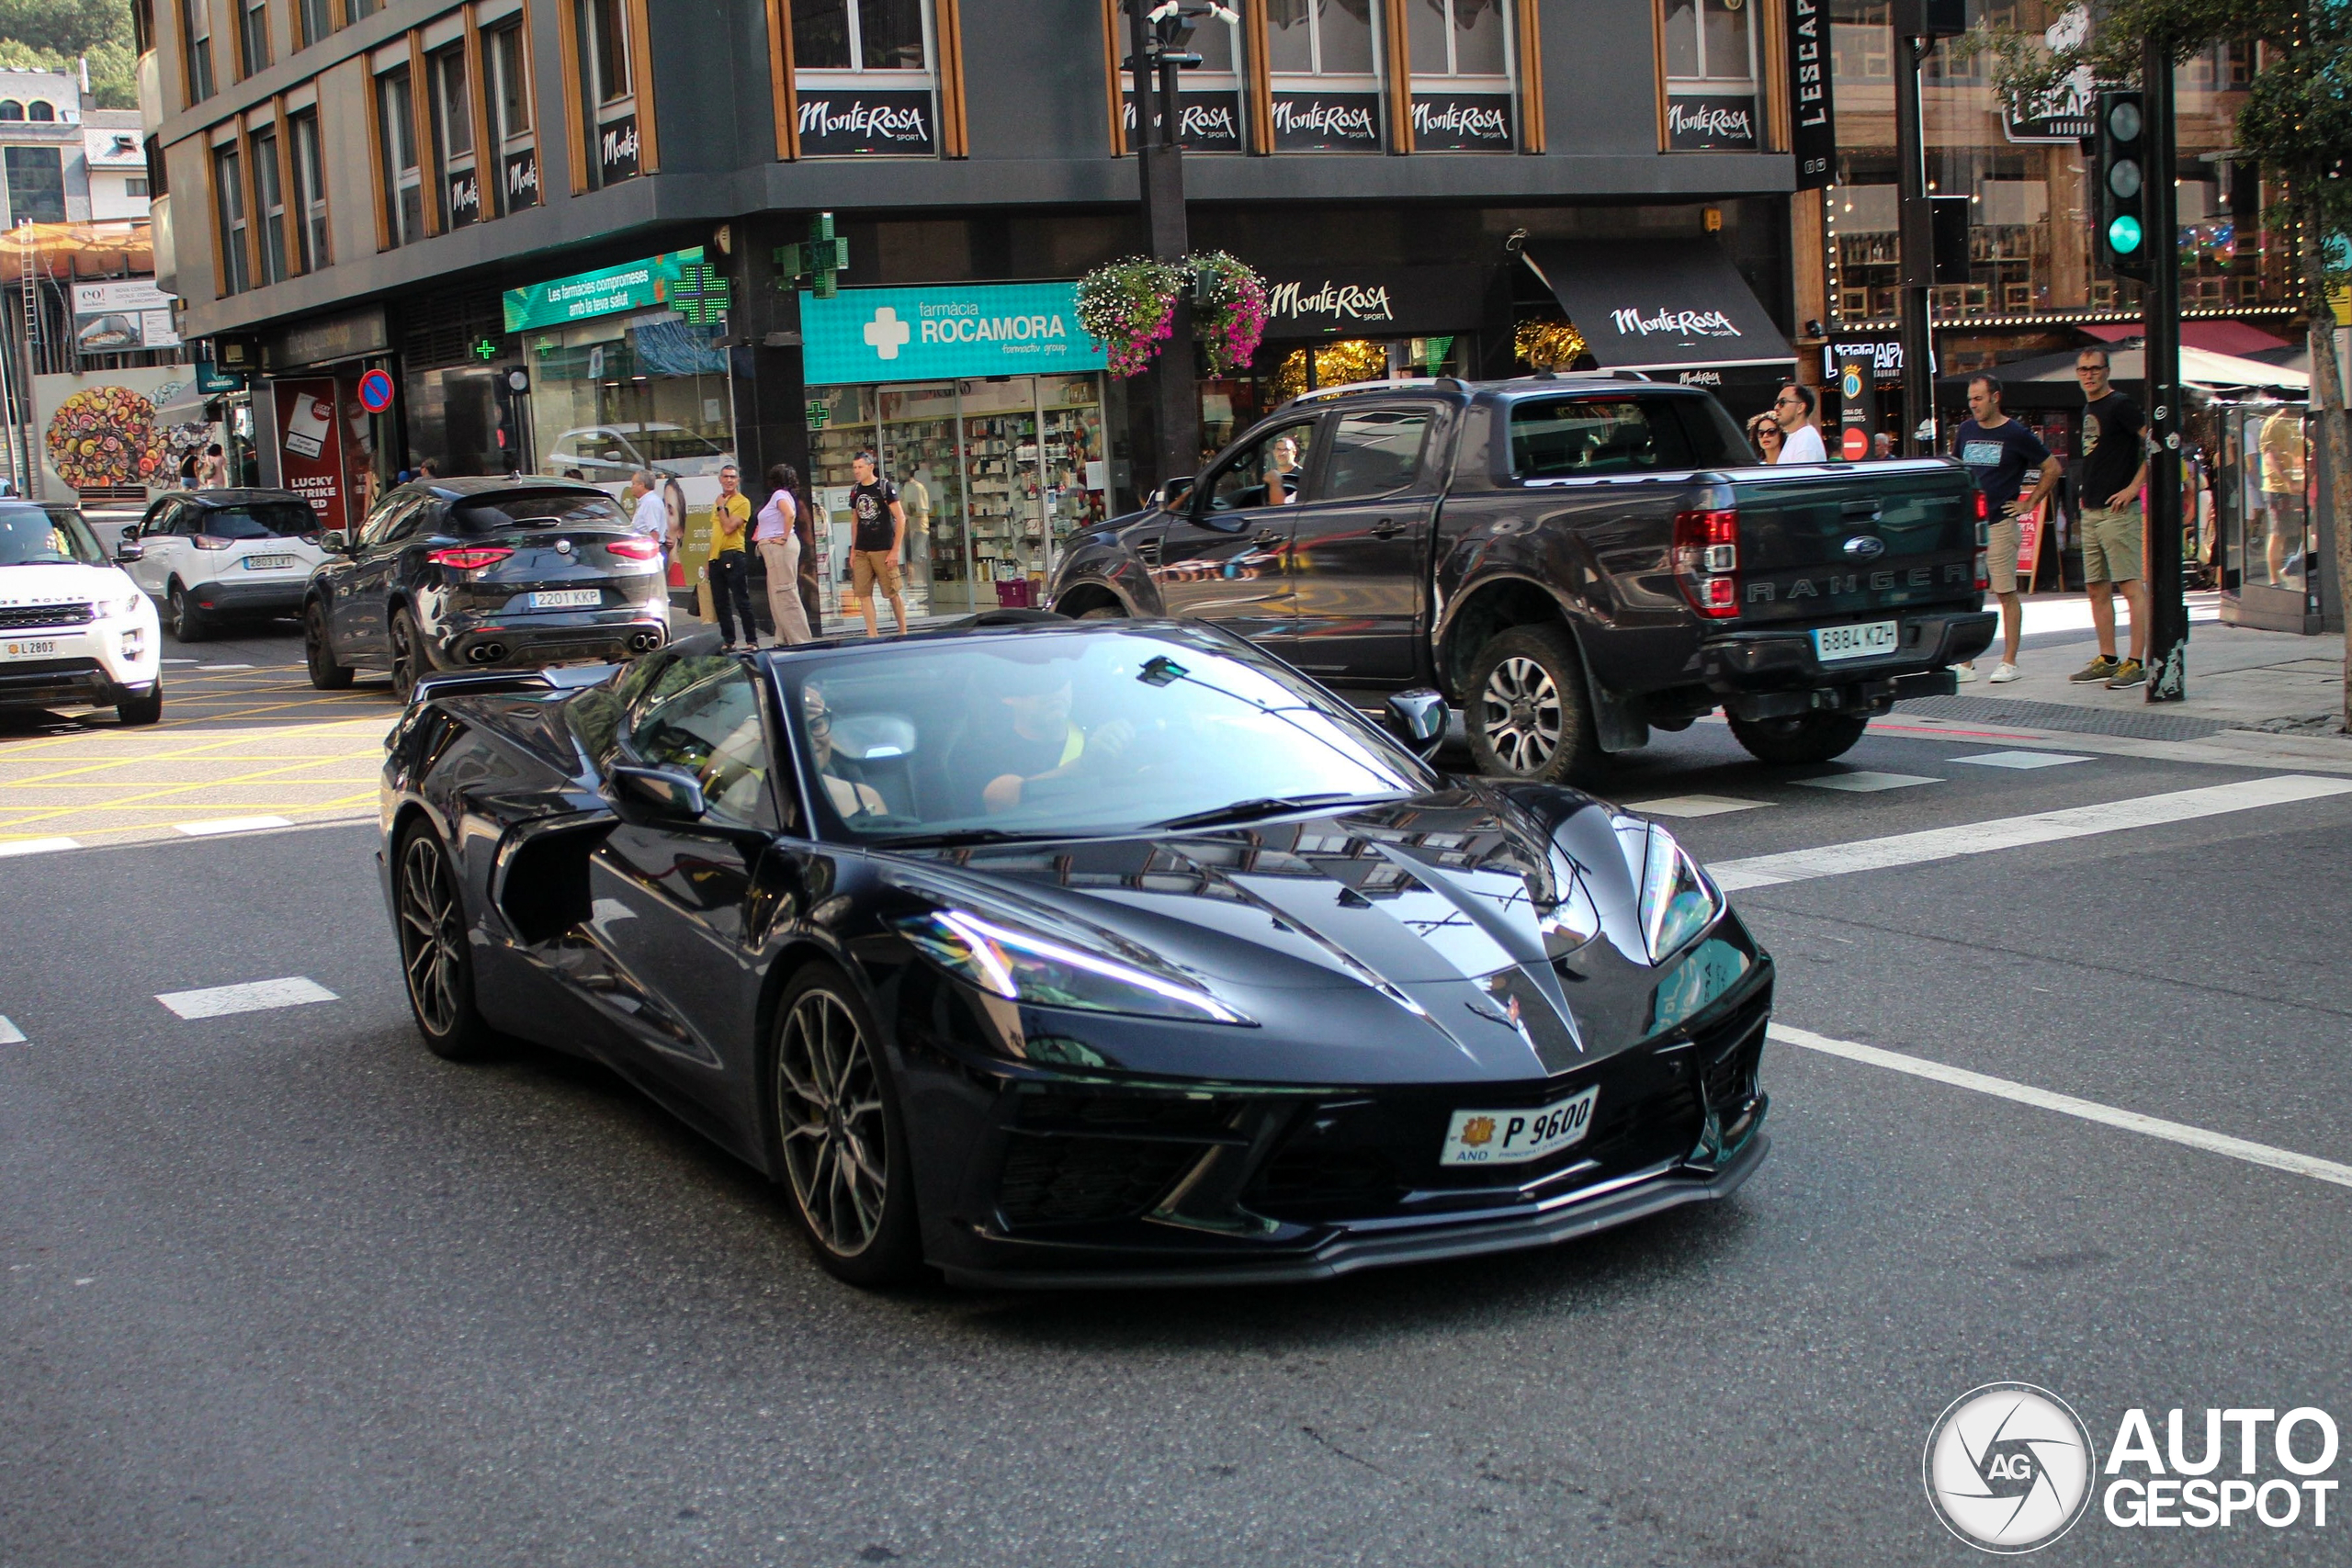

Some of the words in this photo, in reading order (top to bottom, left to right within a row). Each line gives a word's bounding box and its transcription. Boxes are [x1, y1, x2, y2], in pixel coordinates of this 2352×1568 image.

[1796, 0, 1826, 127] L'ESCAP
[548, 288, 561, 303] Les
[561, 280, 596, 299] farmàcies
[596, 269, 649, 293] compromeses
[569, 302, 584, 316] amb
[584, 300, 593, 313] la
[593, 298, 609, 311] teva
[609, 291, 628, 309] salut
[919, 301, 979, 317] farmàcia
[921, 315, 1067, 344] ROCAMORA
[1001, 343, 1041, 355] farmactiv
[1044, 343, 1068, 356] group
[290, 476, 334, 488] LUCKY
[309, 499, 327, 508] ED
[250, 558, 273, 567] 2803
[275, 557, 291, 565] LVT
[1747, 563, 1968, 603] RANGER
[538, 592, 570, 605] 2201
[573, 592, 597, 604] KKP
[1822, 629, 1860, 651] 6884
[1865, 626, 1894, 645] KZH
[21, 644, 28, 654] L
[29, 642, 54, 653] 2803
[1503, 1117, 1525, 1148] P
[1530, 1098, 1590, 1145] 9600
[1456, 1151, 1488, 1162] AND
